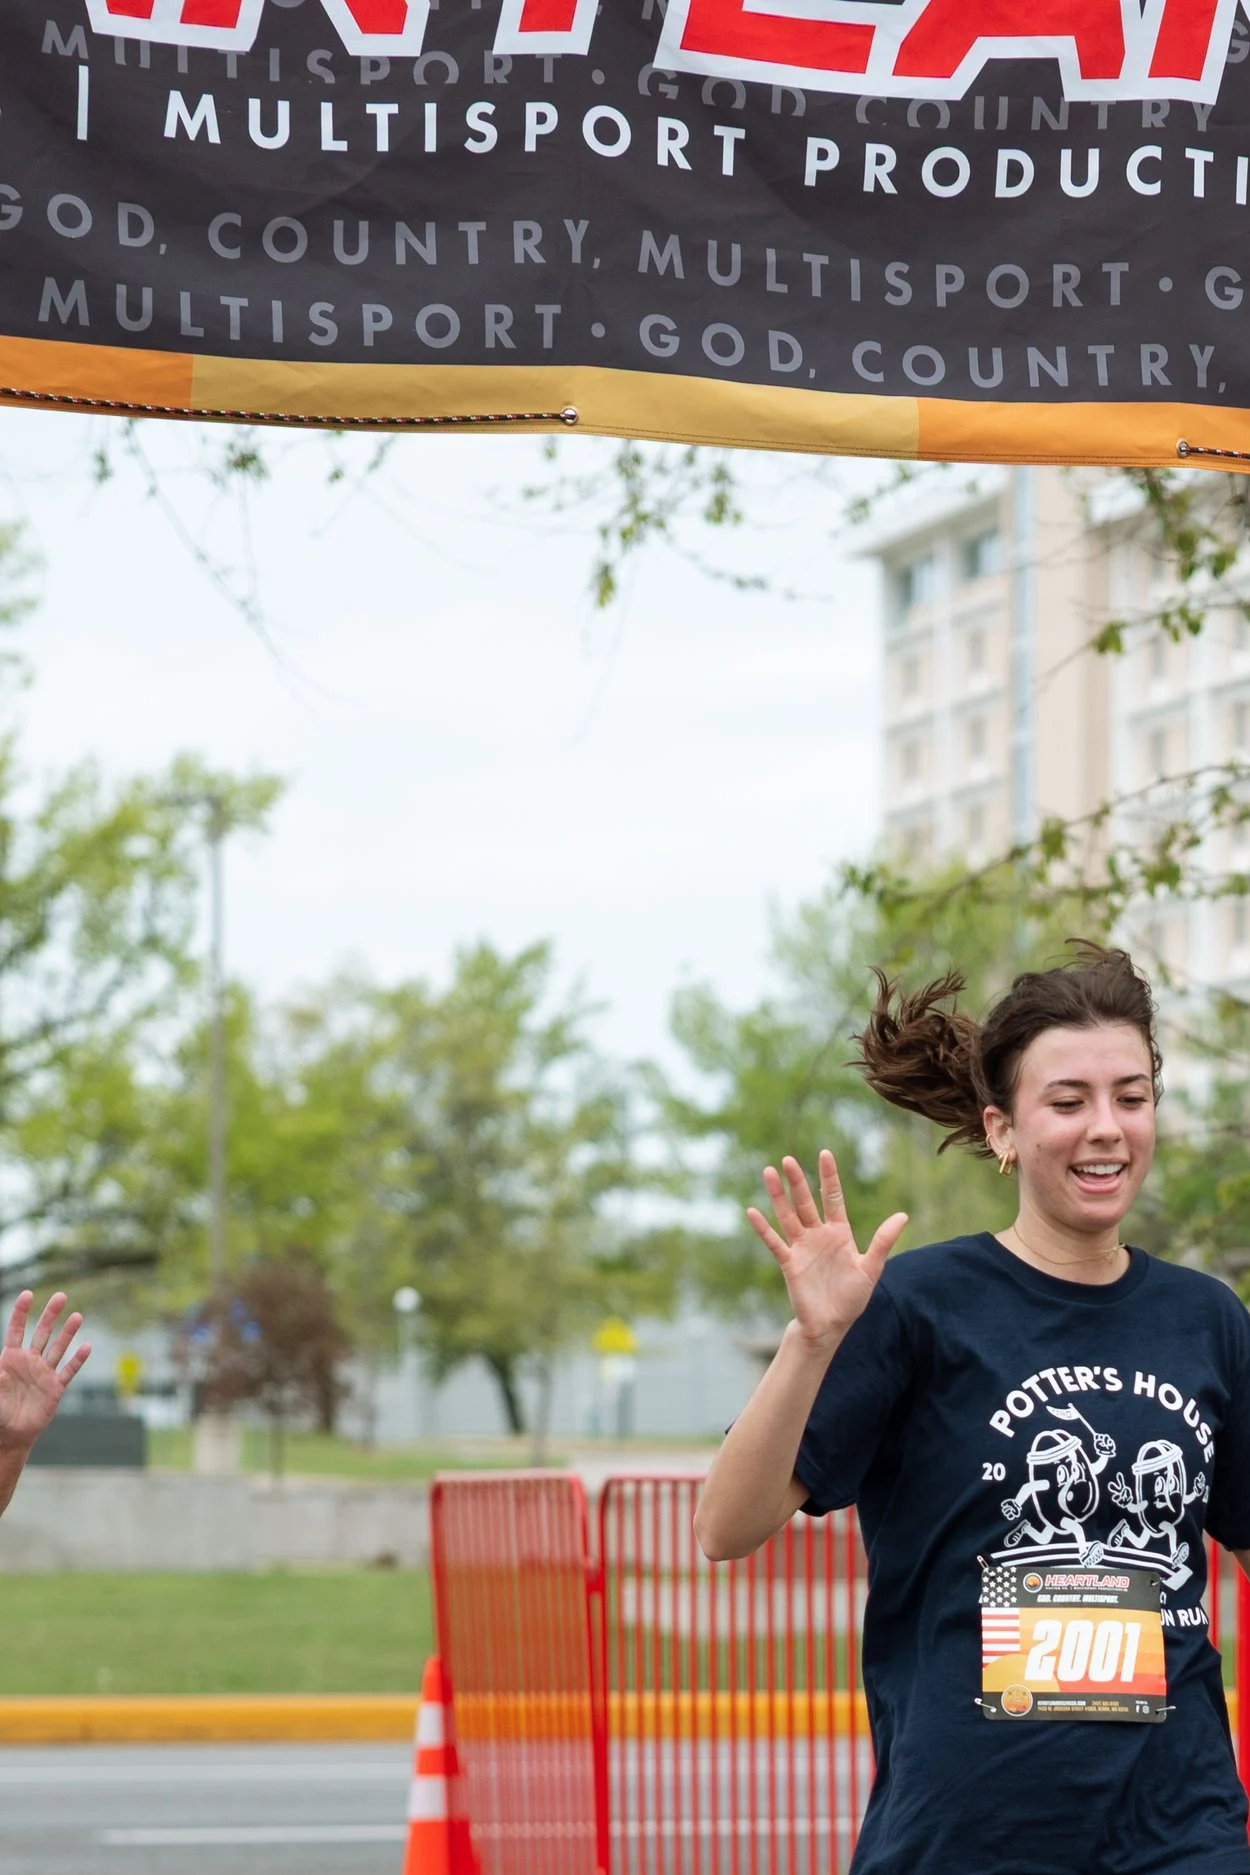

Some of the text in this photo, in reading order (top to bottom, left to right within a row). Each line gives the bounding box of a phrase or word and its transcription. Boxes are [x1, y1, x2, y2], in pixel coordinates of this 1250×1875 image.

[164, 90, 746, 176] MULTISPORT
[207, 212, 601, 269] COUNTRY,
[638, 230, 1129, 308] MULTISPORT
[38, 277, 561, 349] MULTISPORT
[639, 314, 816, 379] GOD,
[852, 342, 1226, 393] COUNTRY,
[989, 1366, 1214, 1464] POTTER'S HOUSE
[982, 1462, 1006, 1481] 20
[1044, 1574, 1130, 1588] HEARTLAND
[1023, 1619, 1142, 1683] 2001
